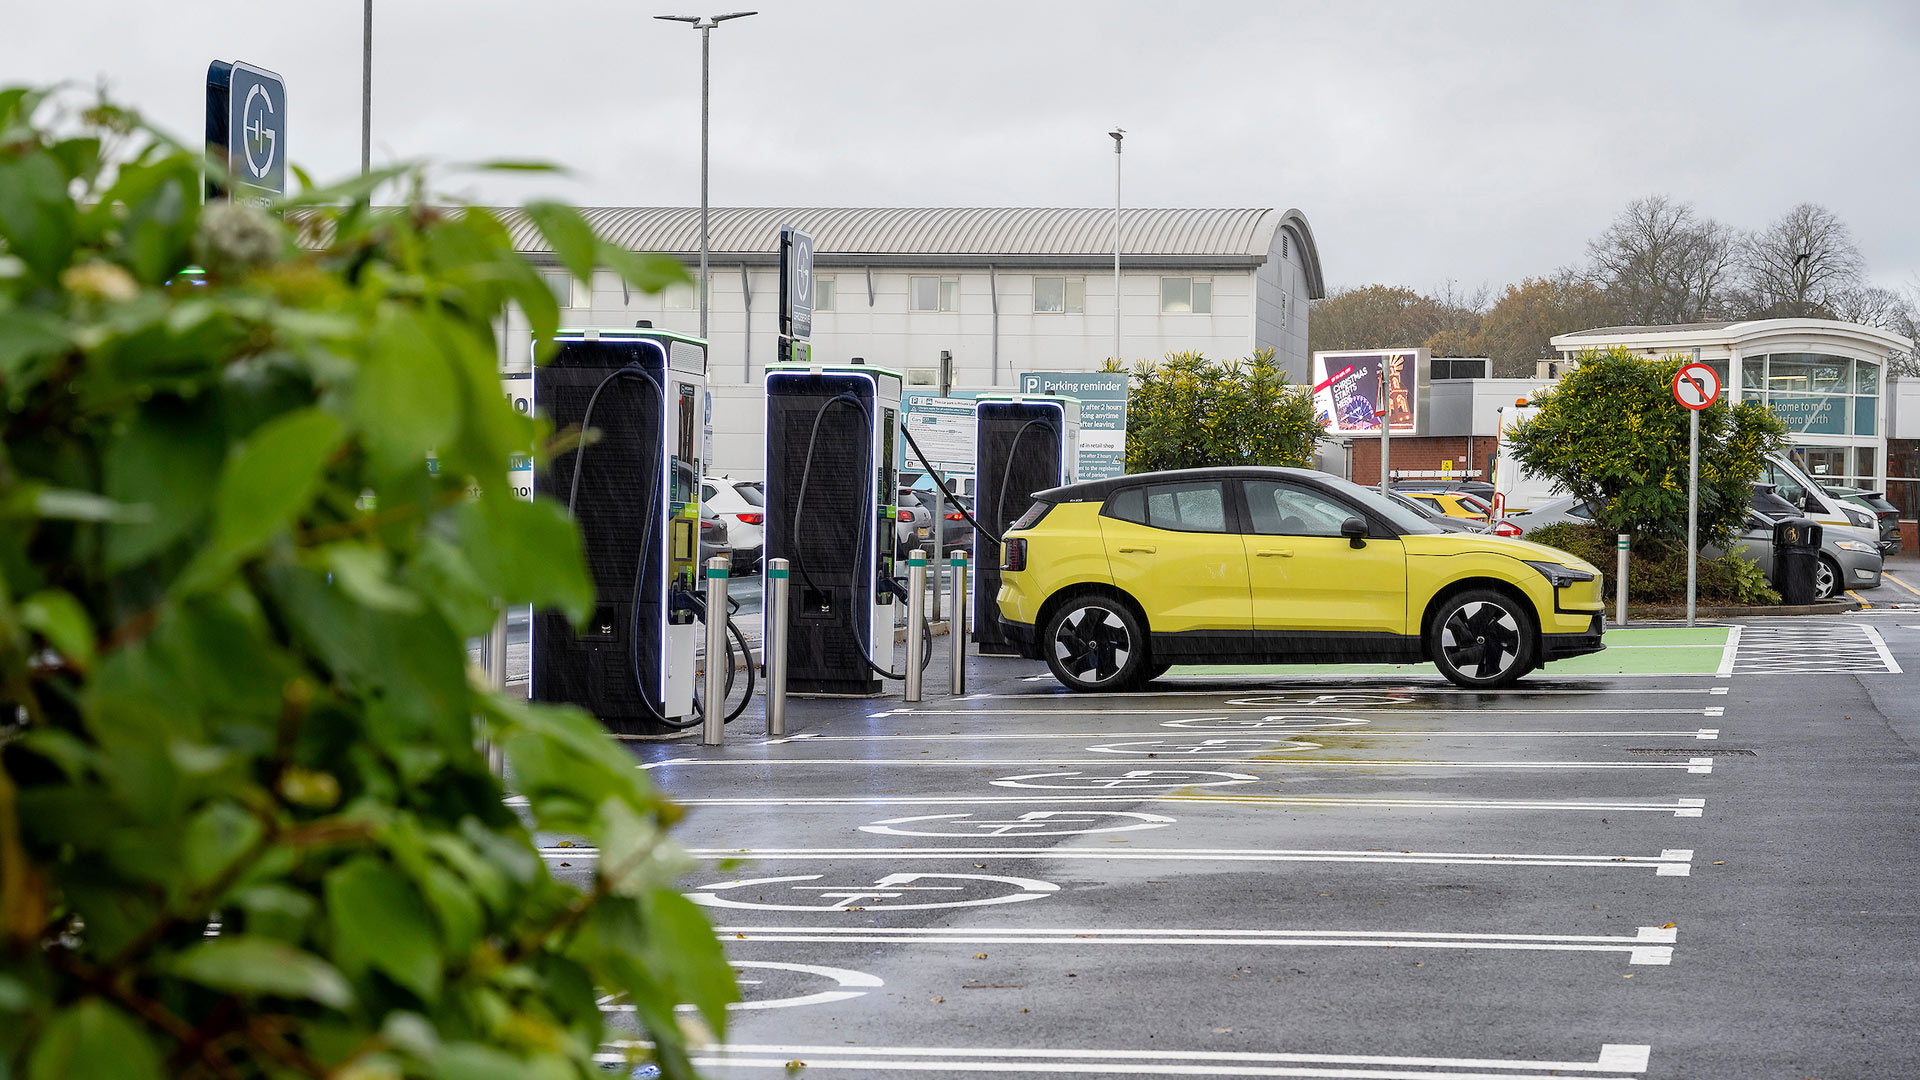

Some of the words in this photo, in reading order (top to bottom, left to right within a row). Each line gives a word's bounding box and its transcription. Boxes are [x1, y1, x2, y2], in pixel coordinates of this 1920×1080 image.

[1333, 366, 1368, 393] CHRISTMAS
[1044, 380, 1079, 393] Parking
[1080, 380, 1122, 391] reminder
[1334, 382, 1358, 402] STARTS
[1105, 403, 1123, 411] hours
[1801, 402, 1810, 411] to
[1811, 402, 1832, 411] moto
[1095, 412, 1120, 420] anytime
[1805, 413, 1829, 424] North
[1094, 421, 1115, 429] leaving
